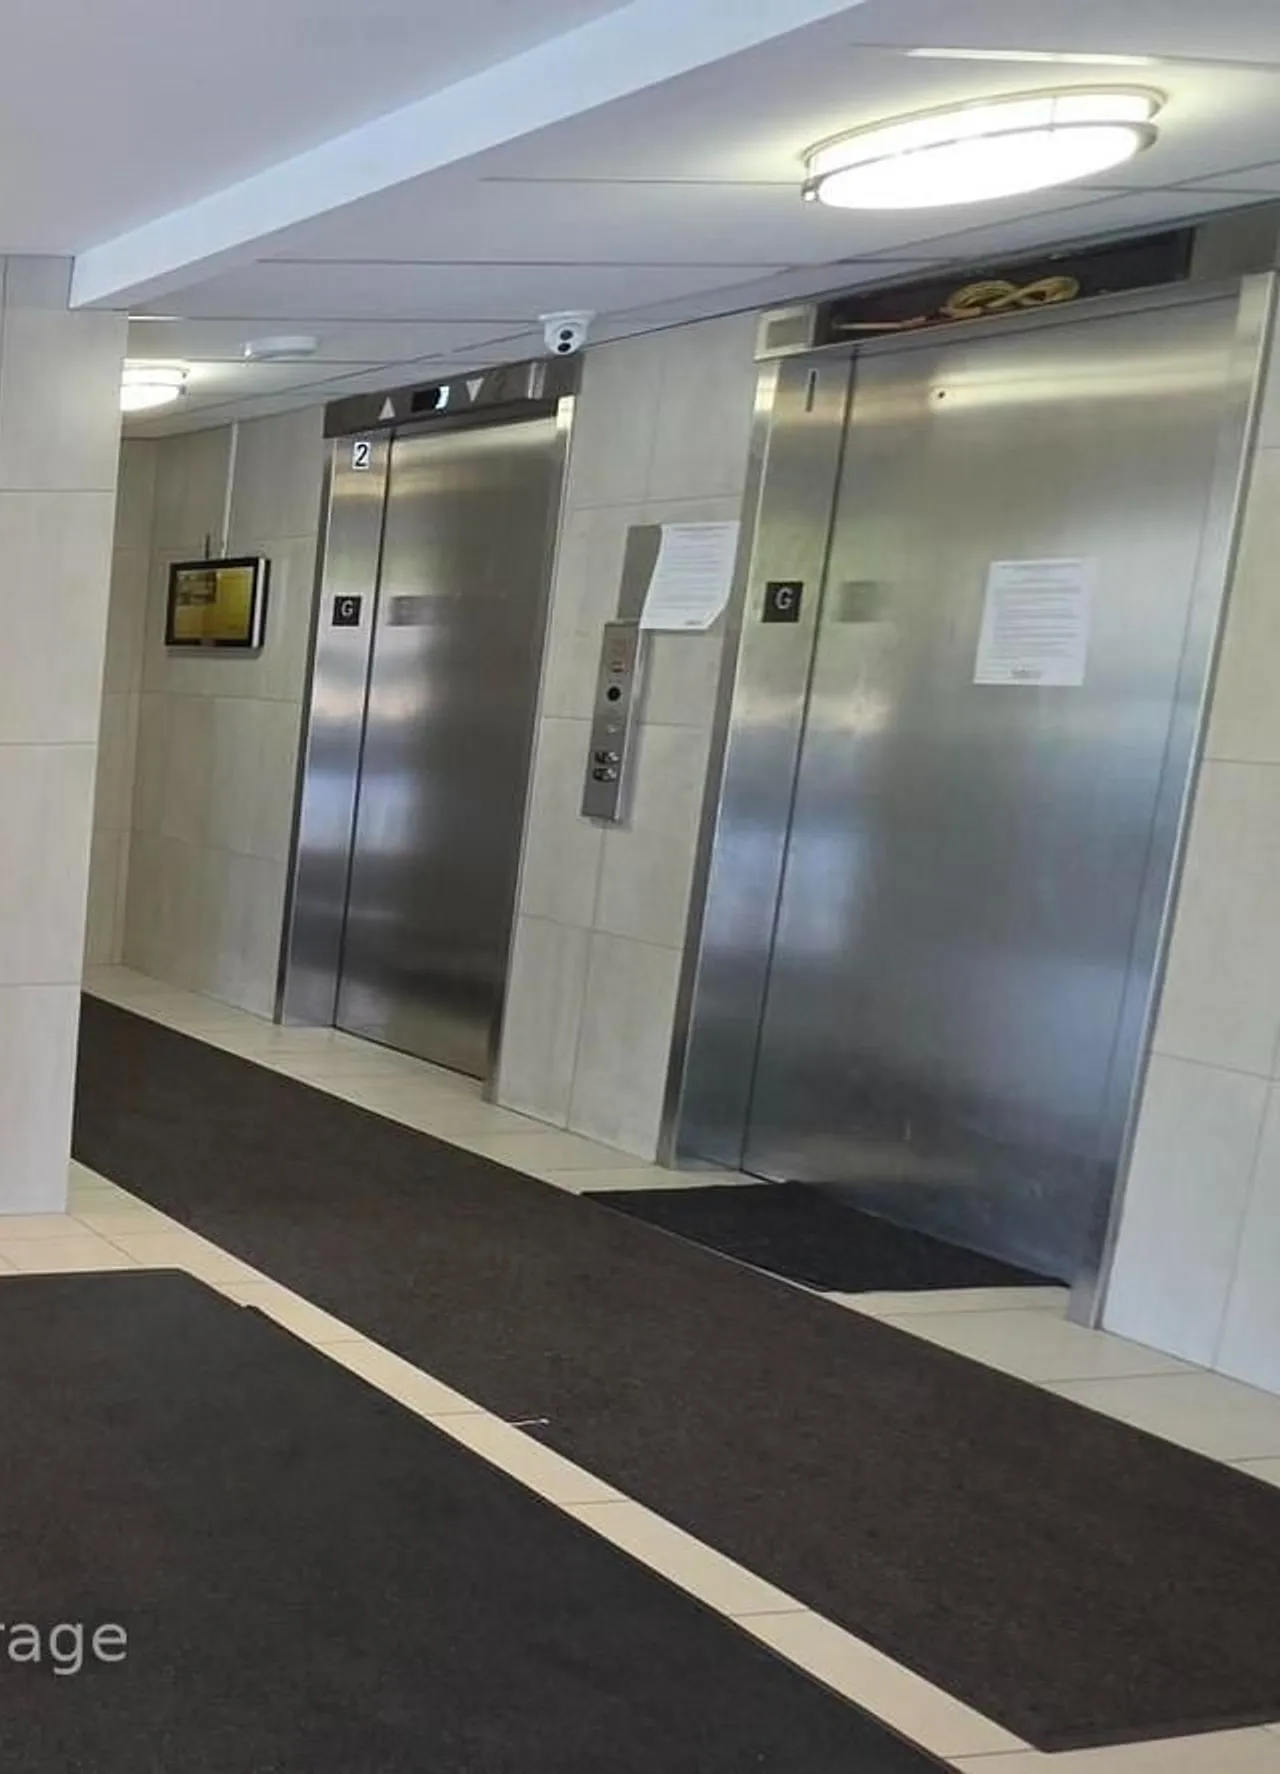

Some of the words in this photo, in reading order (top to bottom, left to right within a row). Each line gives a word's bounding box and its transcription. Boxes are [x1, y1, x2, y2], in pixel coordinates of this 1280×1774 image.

[355, 444, 367, 467] 2
[341, 600, 353, 617] G
[776, 587, 793, 609] G
